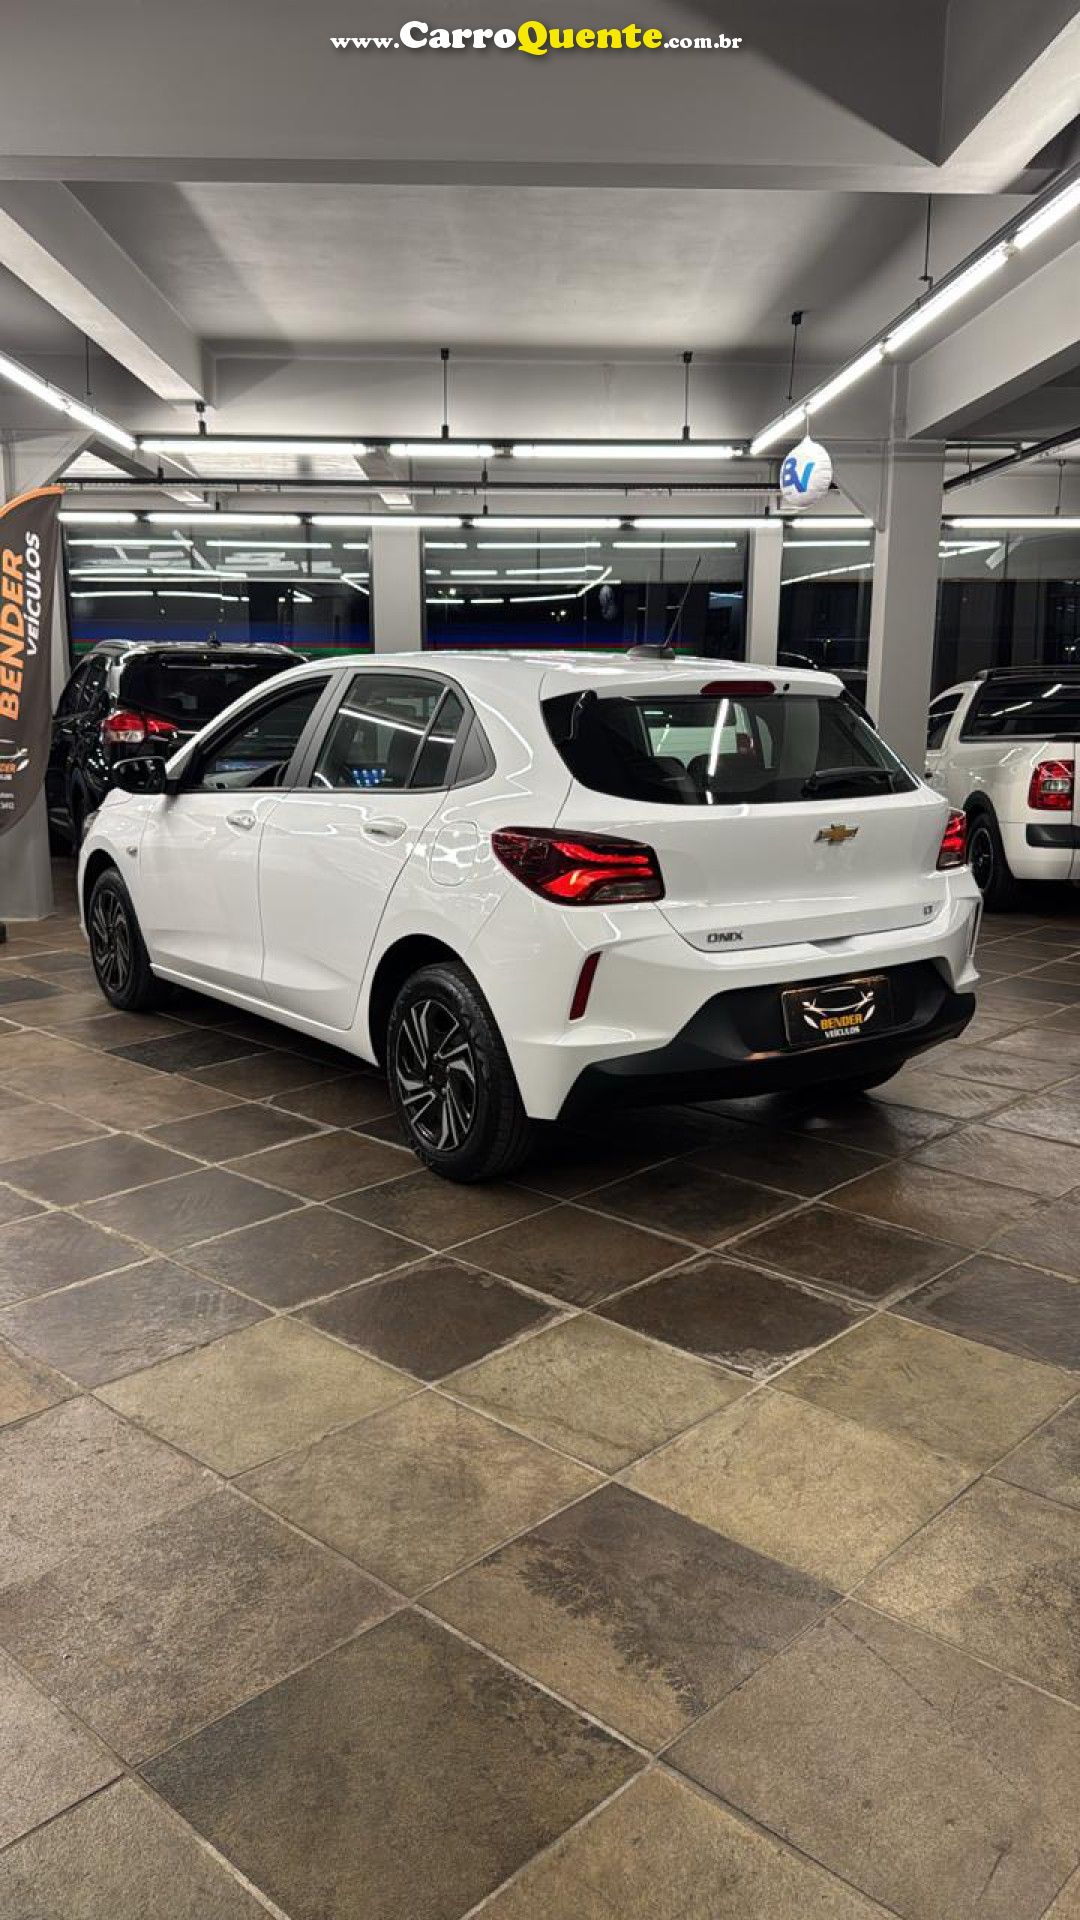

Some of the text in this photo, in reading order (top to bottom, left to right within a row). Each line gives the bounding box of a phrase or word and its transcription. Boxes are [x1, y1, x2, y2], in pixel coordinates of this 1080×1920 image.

[782, 457, 816, 493] BV
[25, 531, 42, 656] VEÍCULOS
[0, 549, 25, 720] BENDER
[707, 930, 744, 942] ONIX
[820, 1013, 864, 1031] BENDER
